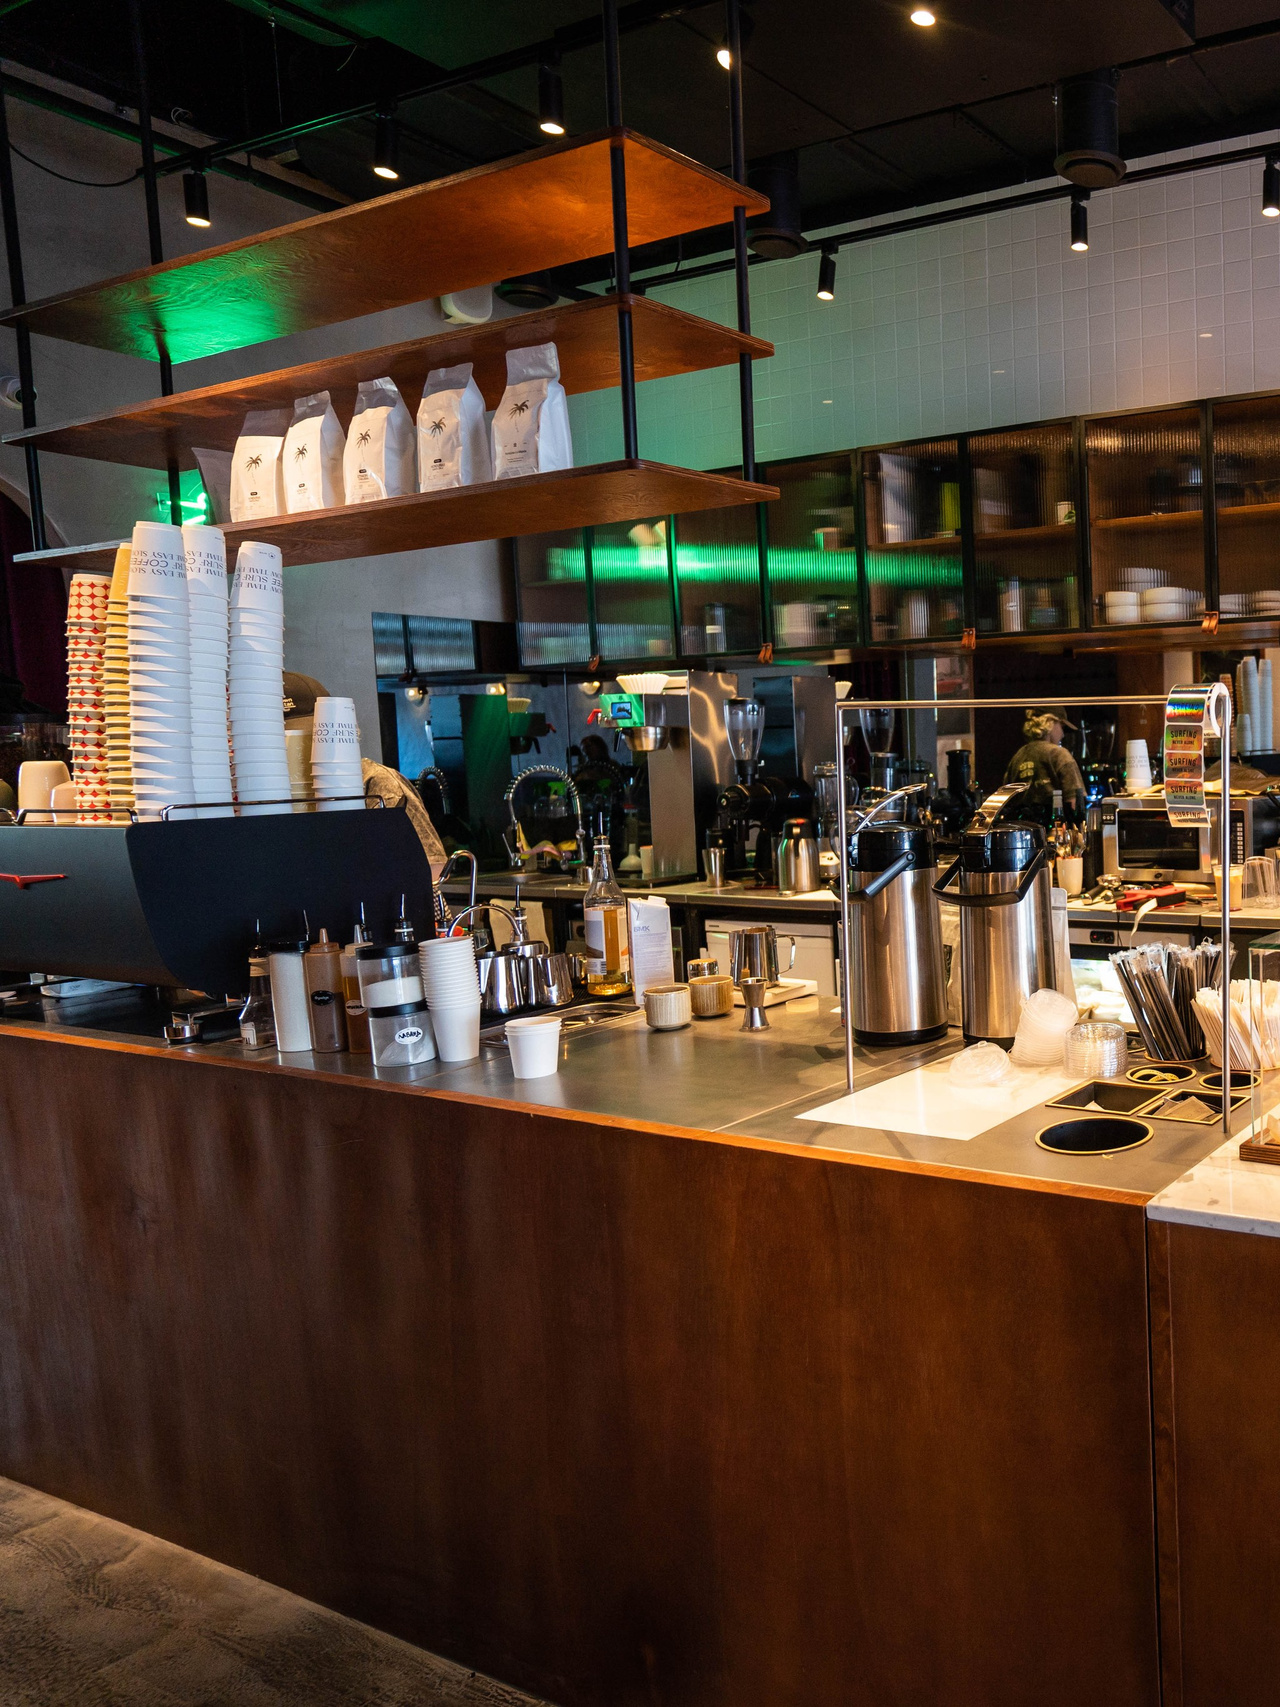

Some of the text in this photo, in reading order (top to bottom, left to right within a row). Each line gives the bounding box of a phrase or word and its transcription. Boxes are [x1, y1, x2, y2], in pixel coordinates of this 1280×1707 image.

[152, 551, 174, 560] EASY
[186, 550, 201, 558] EAS
[199, 559, 224, 570] SURF
[151, 568, 174, 577] EASY
[186, 566, 201, 574] EAS
[242, 574, 268, 583] SURF
[1170, 730, 1198, 738] SURFING
[1170, 758, 1197, 766] SURFING
[1170, 786, 1198, 794] SURFING
